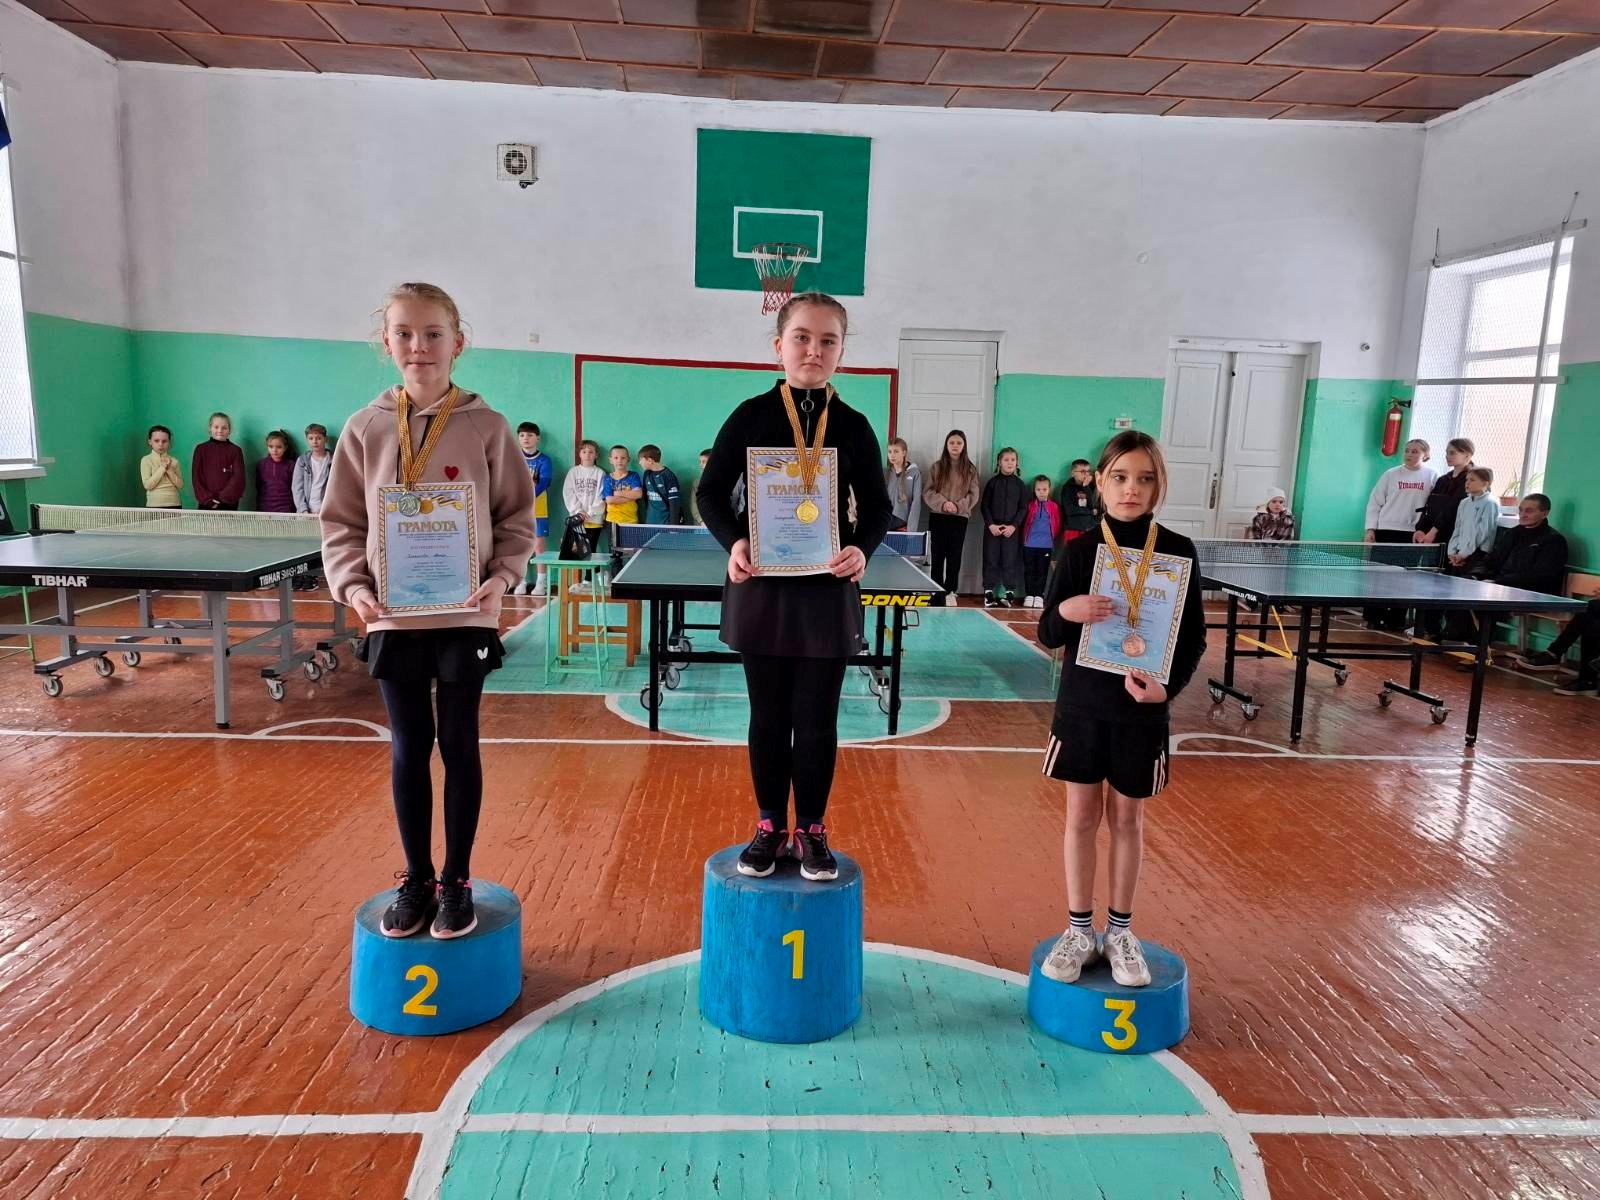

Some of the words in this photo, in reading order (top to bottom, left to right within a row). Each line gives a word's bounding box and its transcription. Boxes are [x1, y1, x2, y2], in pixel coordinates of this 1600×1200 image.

[397, 520, 458, 533] ГРАМОТА
[32, 574, 88, 588] TIBHAR
[259, 571, 281, 587] TIBHAR
[782, 930, 805, 980] 1
[402, 965, 439, 1016] 2
[1101, 998, 1137, 1051] 3
